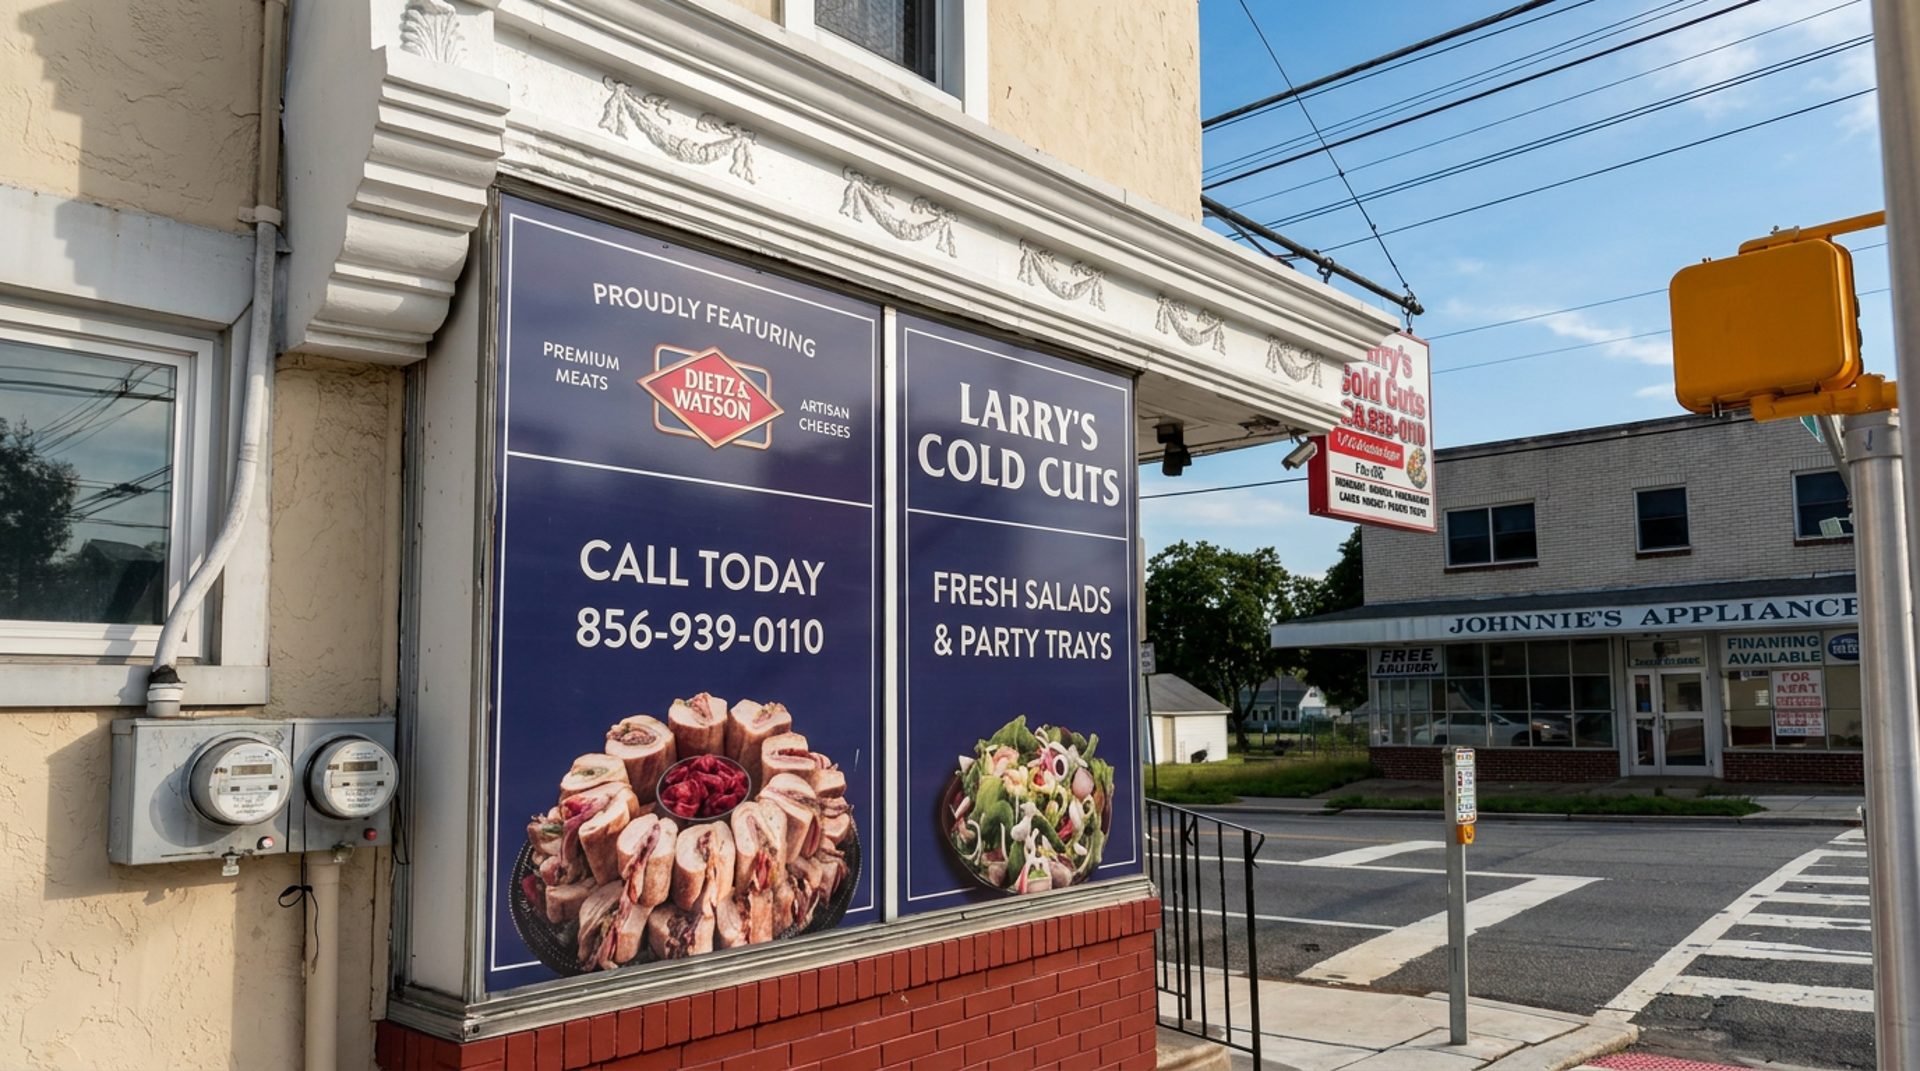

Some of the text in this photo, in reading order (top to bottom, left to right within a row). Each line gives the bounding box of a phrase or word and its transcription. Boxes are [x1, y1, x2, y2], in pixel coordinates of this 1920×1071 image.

[593, 283, 817, 358] PROUDLY FEATURING
[543, 341, 620, 371] PREMIUM
[555, 368, 609, 391] MEATS
[685, 367, 735, 397] DIETZ
[1385, 376, 1425, 420] Cuts
[672, 387, 751, 423] WATSON
[800, 400, 850, 420] ARTISAN
[960, 381, 1099, 452] LARRY'S
[799, 418, 851, 439] CHEESES
[917, 433, 1120, 507] COLD CUTS
[579, 539, 826, 597] CALL TODAY
[933, 571, 1112, 615] FRESH SALADS
[575, 606, 825, 655] 856-939-0110
[1449, 597, 1858, 635] JOHNNIE'S APPLIANCE
[933, 623, 953, 657] &
[960, 625, 1040, 660] PARTY
[1045, 629, 1113, 660] TRAYS
[1380, 648, 1434, 663] FREE
[1727, 651, 1822, 666] AVAILABLE
